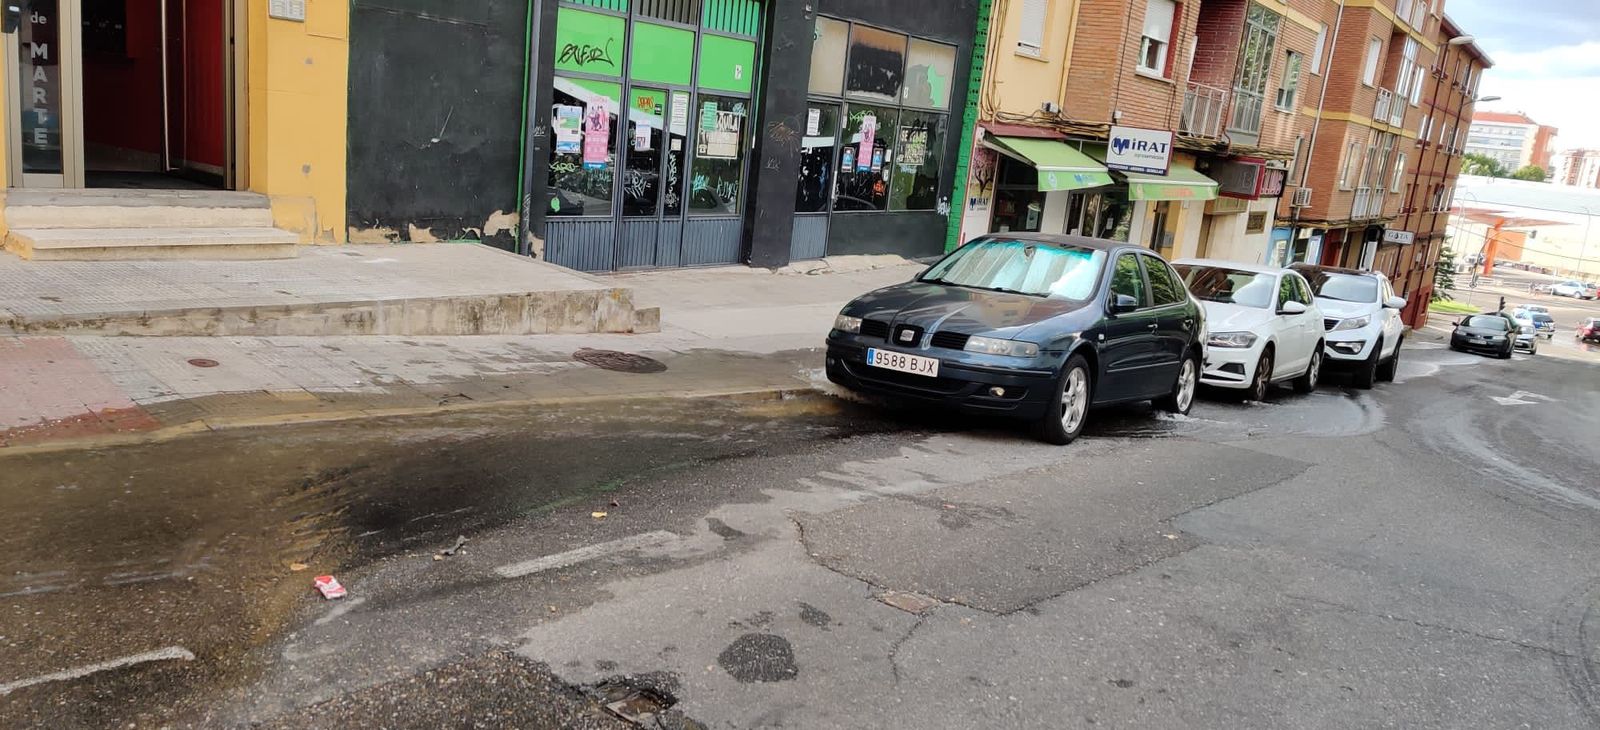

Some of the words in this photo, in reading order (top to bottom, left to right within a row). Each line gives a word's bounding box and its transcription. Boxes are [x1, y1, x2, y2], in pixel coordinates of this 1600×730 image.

[30, 11, 47, 24] de
[30, 42, 49, 144] MARTE
[875, 352, 906, 369] 9588
[910, 358, 935, 374] BJX
